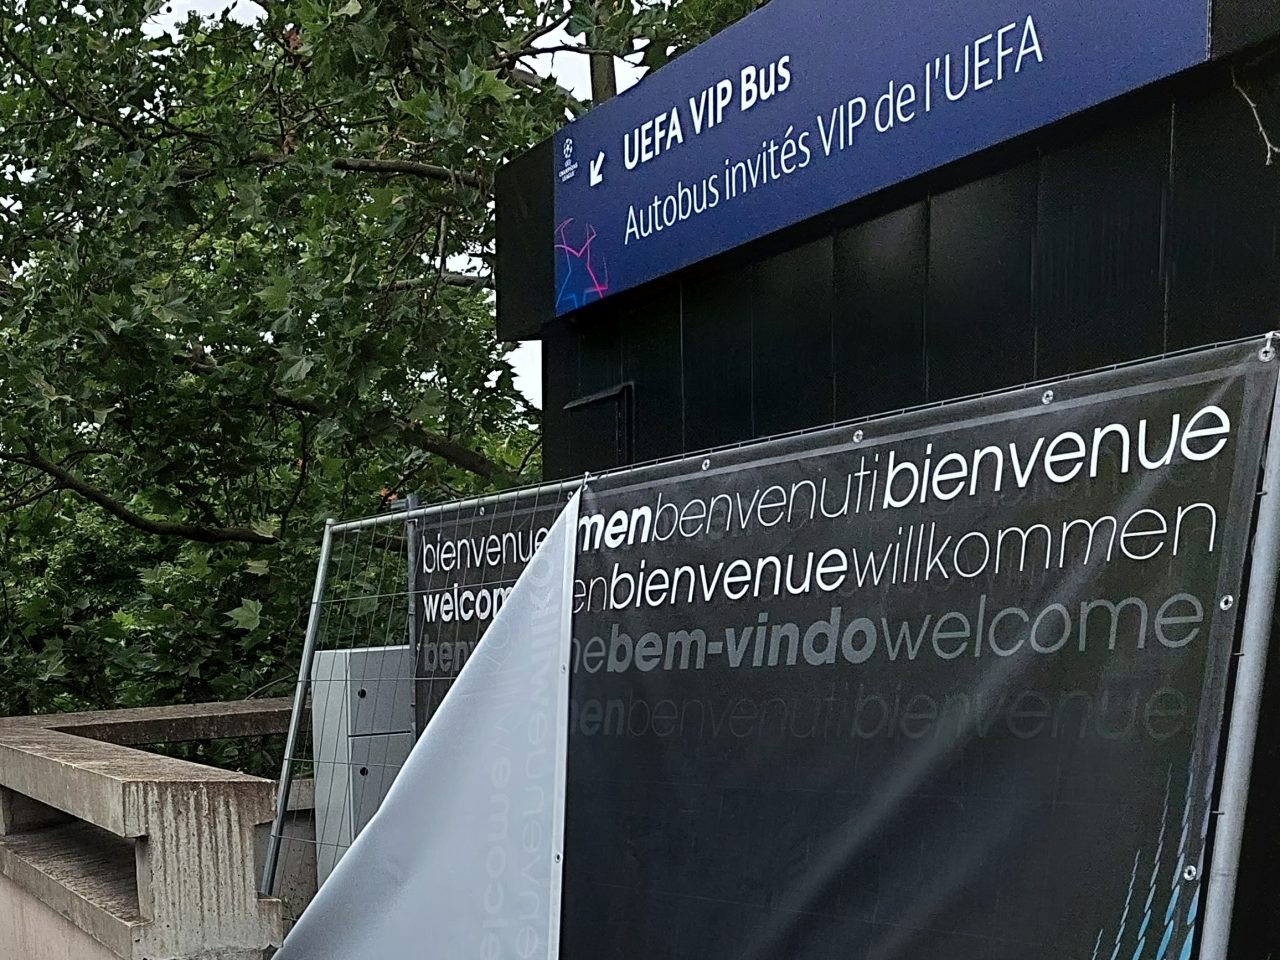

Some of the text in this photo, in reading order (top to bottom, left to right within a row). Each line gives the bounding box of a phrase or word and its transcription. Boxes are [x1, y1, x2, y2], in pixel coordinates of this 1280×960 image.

[623, 107, 684, 171] UEFA
[689, 78, 733, 135] VIP
[740, 55, 792, 112] Bus
[624, 15, 1044, 245] Autobus invités VIP de l'UEFA
